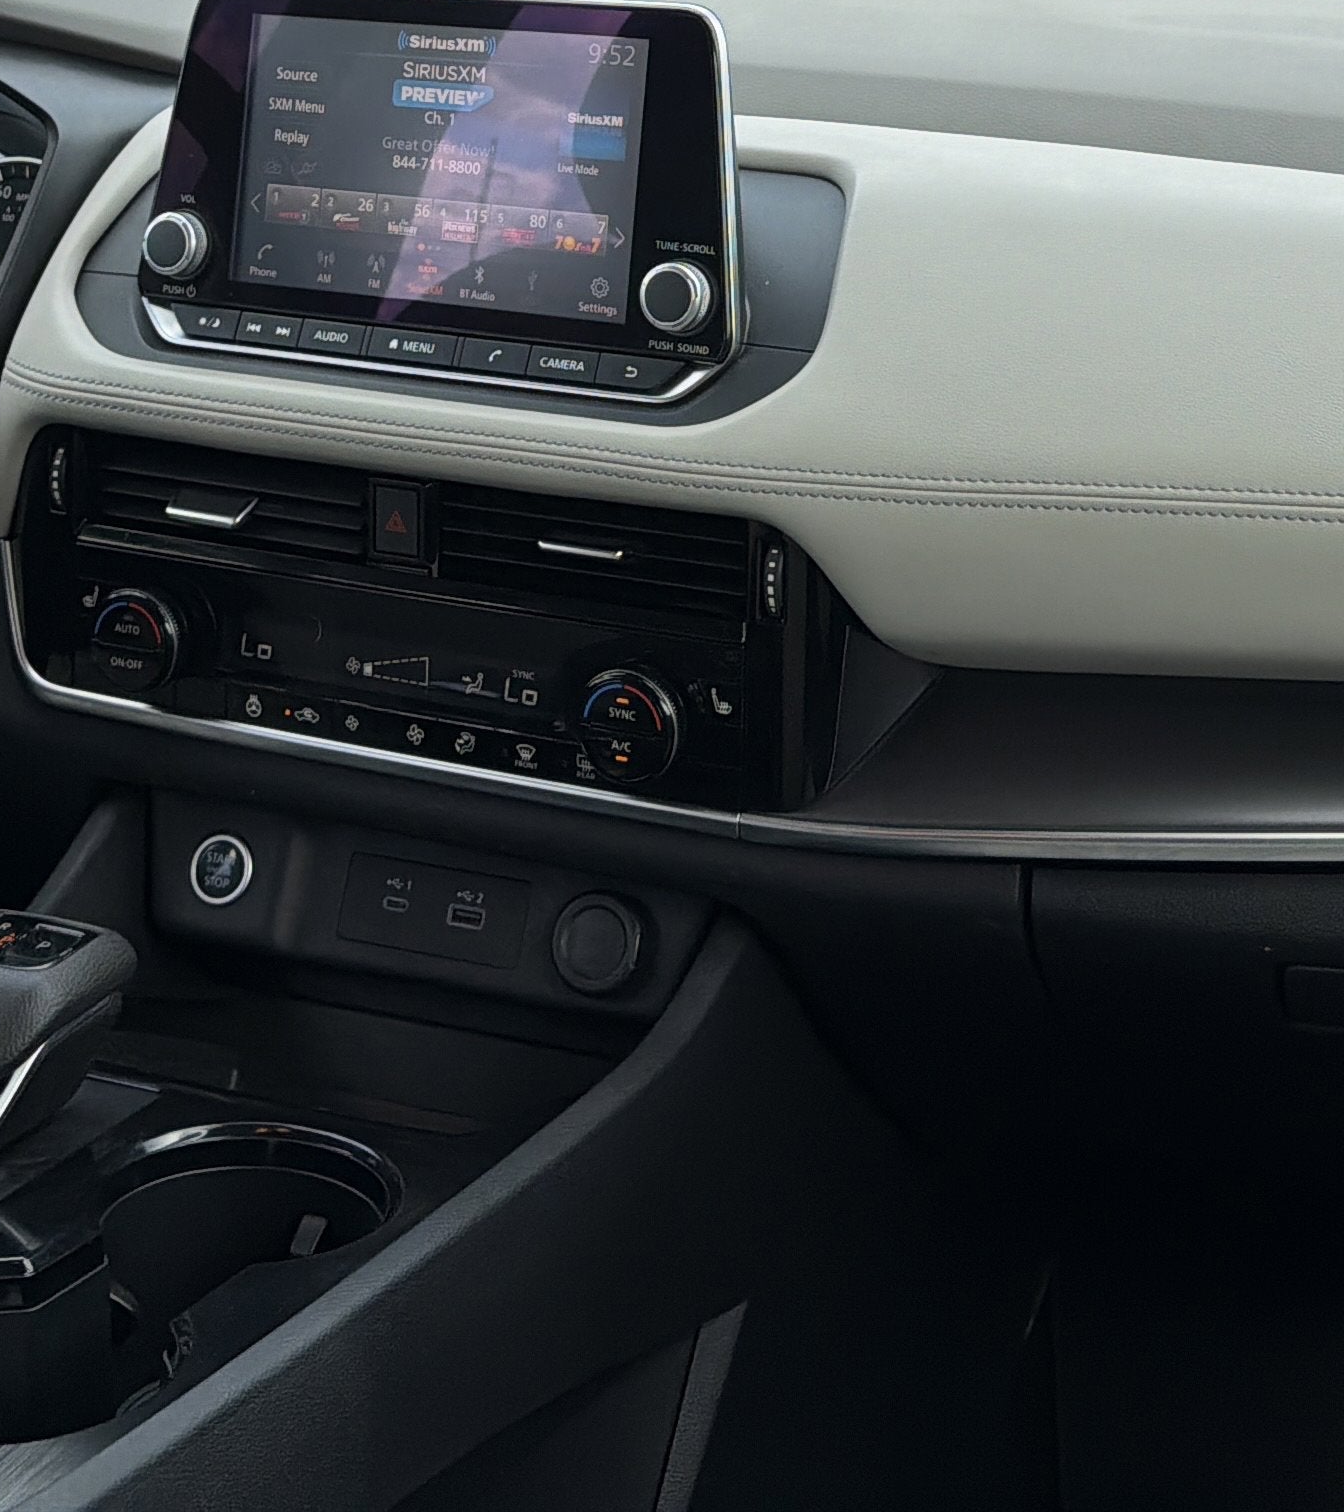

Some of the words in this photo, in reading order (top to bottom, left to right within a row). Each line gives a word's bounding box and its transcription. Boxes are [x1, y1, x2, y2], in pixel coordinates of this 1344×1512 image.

[588, 42, 636, 66] 9:52
[276, 66, 318, 83] Source
[402, 61, 487, 83] SIRIUSXM
[400, 86, 485, 105] PREVIEW
[268, 96, 293, 112] SXM
[294, 98, 325, 114] Menu
[424, 111, 445, 126] Ch.
[449, 113, 456, 127] 1
[274, 128, 310, 146] Replay
[382, 136, 419, 152] Great
[422, 138, 457, 154] Offer
[460, 142, 496, 158] Now!
[392, 154, 481, 175] 844-711-8800
[557, 162, 574, 175] Live
[574, 164, 600, 177] Mode
[180, 194, 197, 205] VOL
[272, 191, 279, 202] 1
[311, 194, 319, 207] 2
[327, 197, 334, 207] 2
[357, 198, 375, 213] 26
[383, 201, 390, 212] 3
[414, 203, 430, 218] 56
[439, 206, 446, 217] 4
[464, 208, 489, 224] 115
[497, 213, 504, 223] 5
[529, 215, 547, 229] 80
[556, 219, 564, 229] 6
[597, 221, 607, 235] 7
[249, 265, 277, 279] Phone
[317, 273, 332, 284] AM
[162, 284, 186, 296] PUSH
[367, 278, 381, 289] FM
[459, 288, 471, 299] BT
[471, 290, 496, 302] Audio
[577, 301, 619, 318] Settings
[313, 330, 349, 345] AUDIO
[402, 340, 436, 354] MENU
[648, 339, 674, 353] PUSH
[677, 342, 710, 356] SOUND
[539, 356, 586, 372] CAMERA
[114, 622, 141, 636] AUTO
[511, 668, 536, 681] SYNC
[608, 706, 637, 722] SYNC
[610, 739, 632, 754] A/C
[514, 759, 539, 771] FRONT
[203, 875, 231, 889] STOP
[34, 940, 52, 950] P
